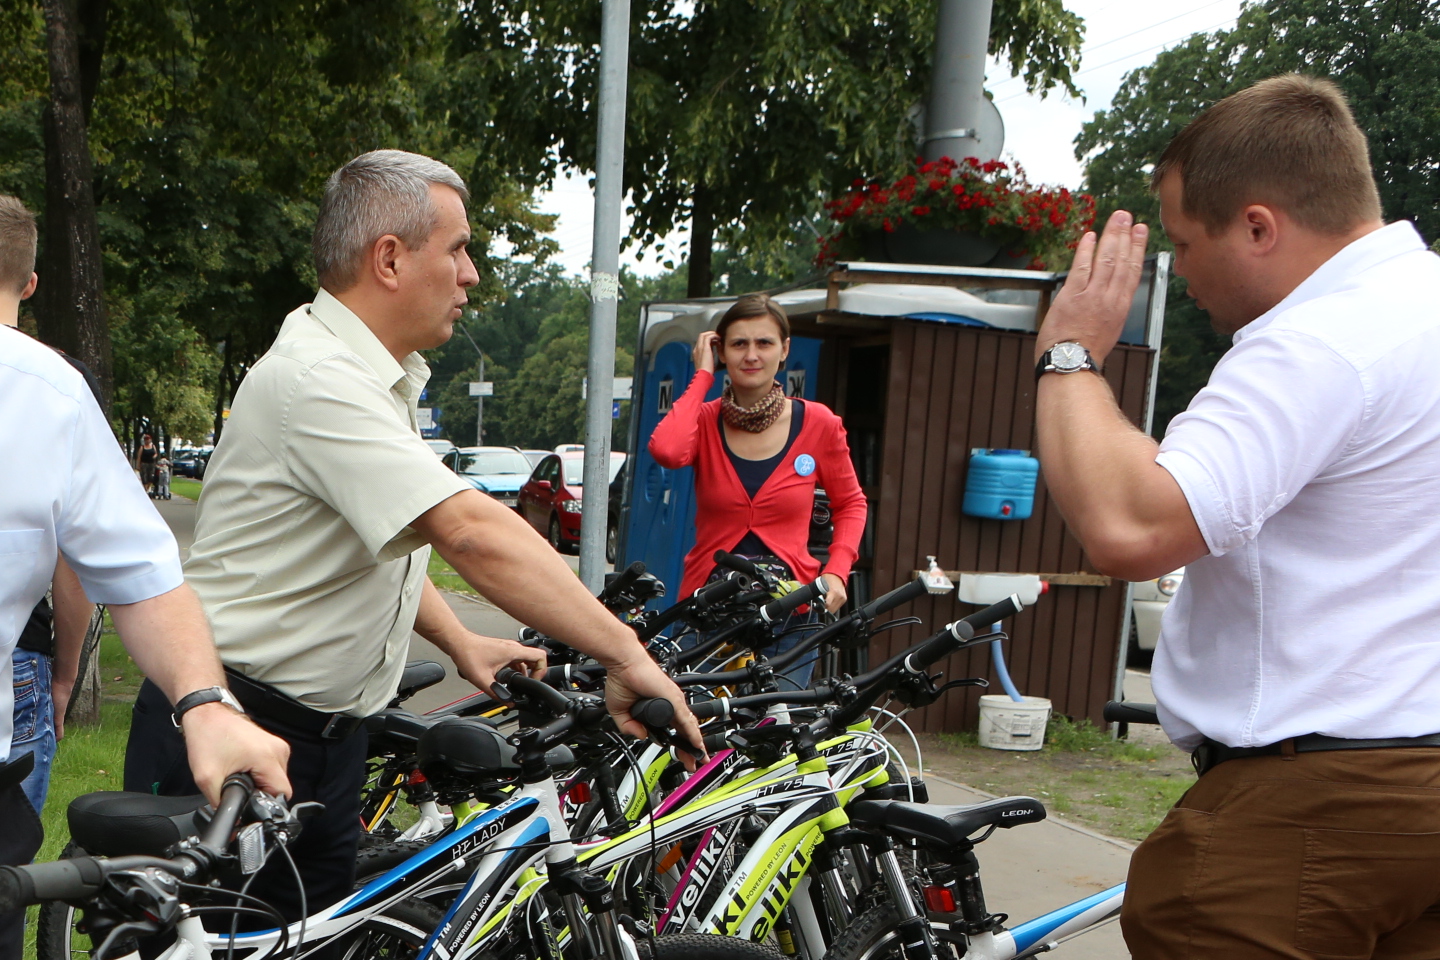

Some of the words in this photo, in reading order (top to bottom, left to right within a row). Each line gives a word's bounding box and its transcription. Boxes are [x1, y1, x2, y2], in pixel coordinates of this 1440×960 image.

[648, 768, 658, 785] LEON
[755, 783, 778, 798] HT
[783, 778, 803, 791] 75
[1002, 809, 1031, 818] LEON
[473, 818, 506, 847] LADY
[670, 827, 727, 926] veliki
[734, 871, 748, 888] TM
[746, 871, 769, 901] POWERED
[767, 860, 775, 871] BY
[773, 843, 788, 861] LEON
[750, 848, 808, 942] eliki
[438, 922, 453, 940] TM
[449, 919, 473, 953] POWERED
[470, 911, 479, 923] BY
[476, 893, 491, 914] LEON
